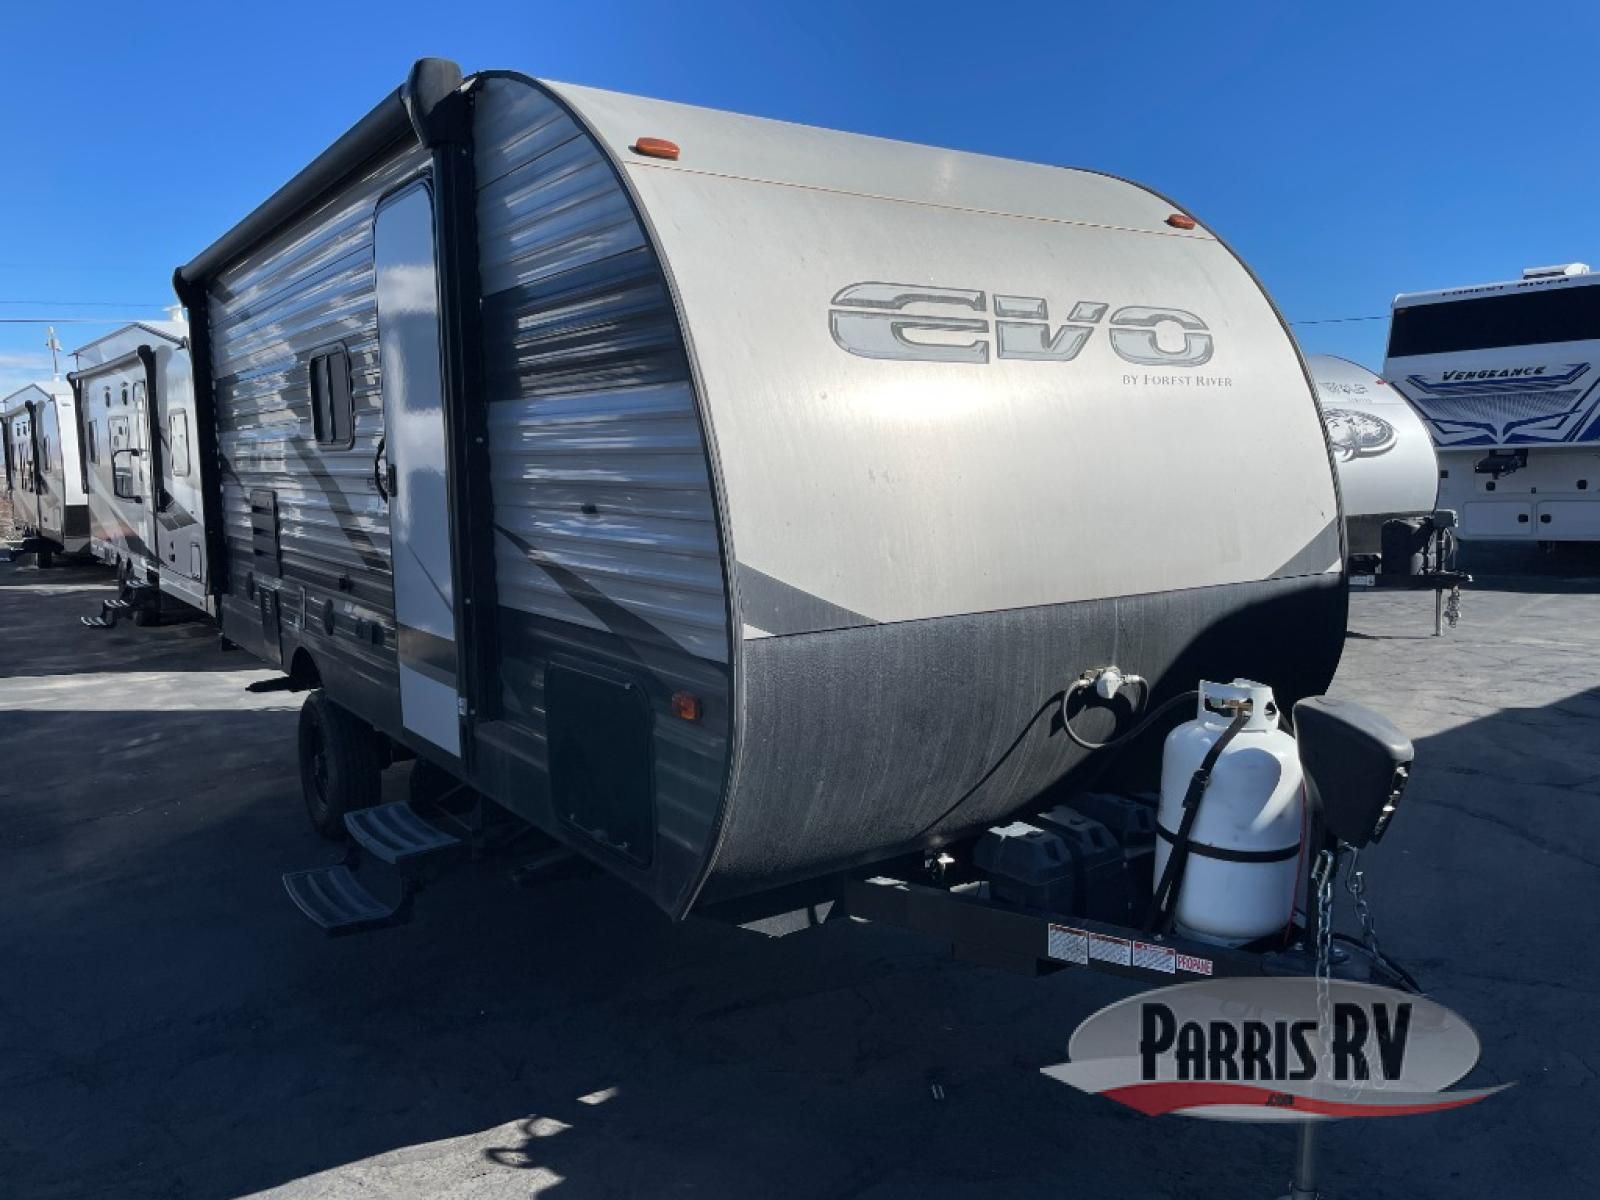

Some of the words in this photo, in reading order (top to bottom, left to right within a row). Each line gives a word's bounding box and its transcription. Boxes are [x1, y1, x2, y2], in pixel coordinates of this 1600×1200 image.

[1122, 374, 1138, 385] BY
[1143, 374, 1192, 386] FOREST
[1196, 375, 1232, 387] RIVER
[1443, 366, 1546, 381] VENGEANCE
[1177, 955, 1213, 974] PROPANE
